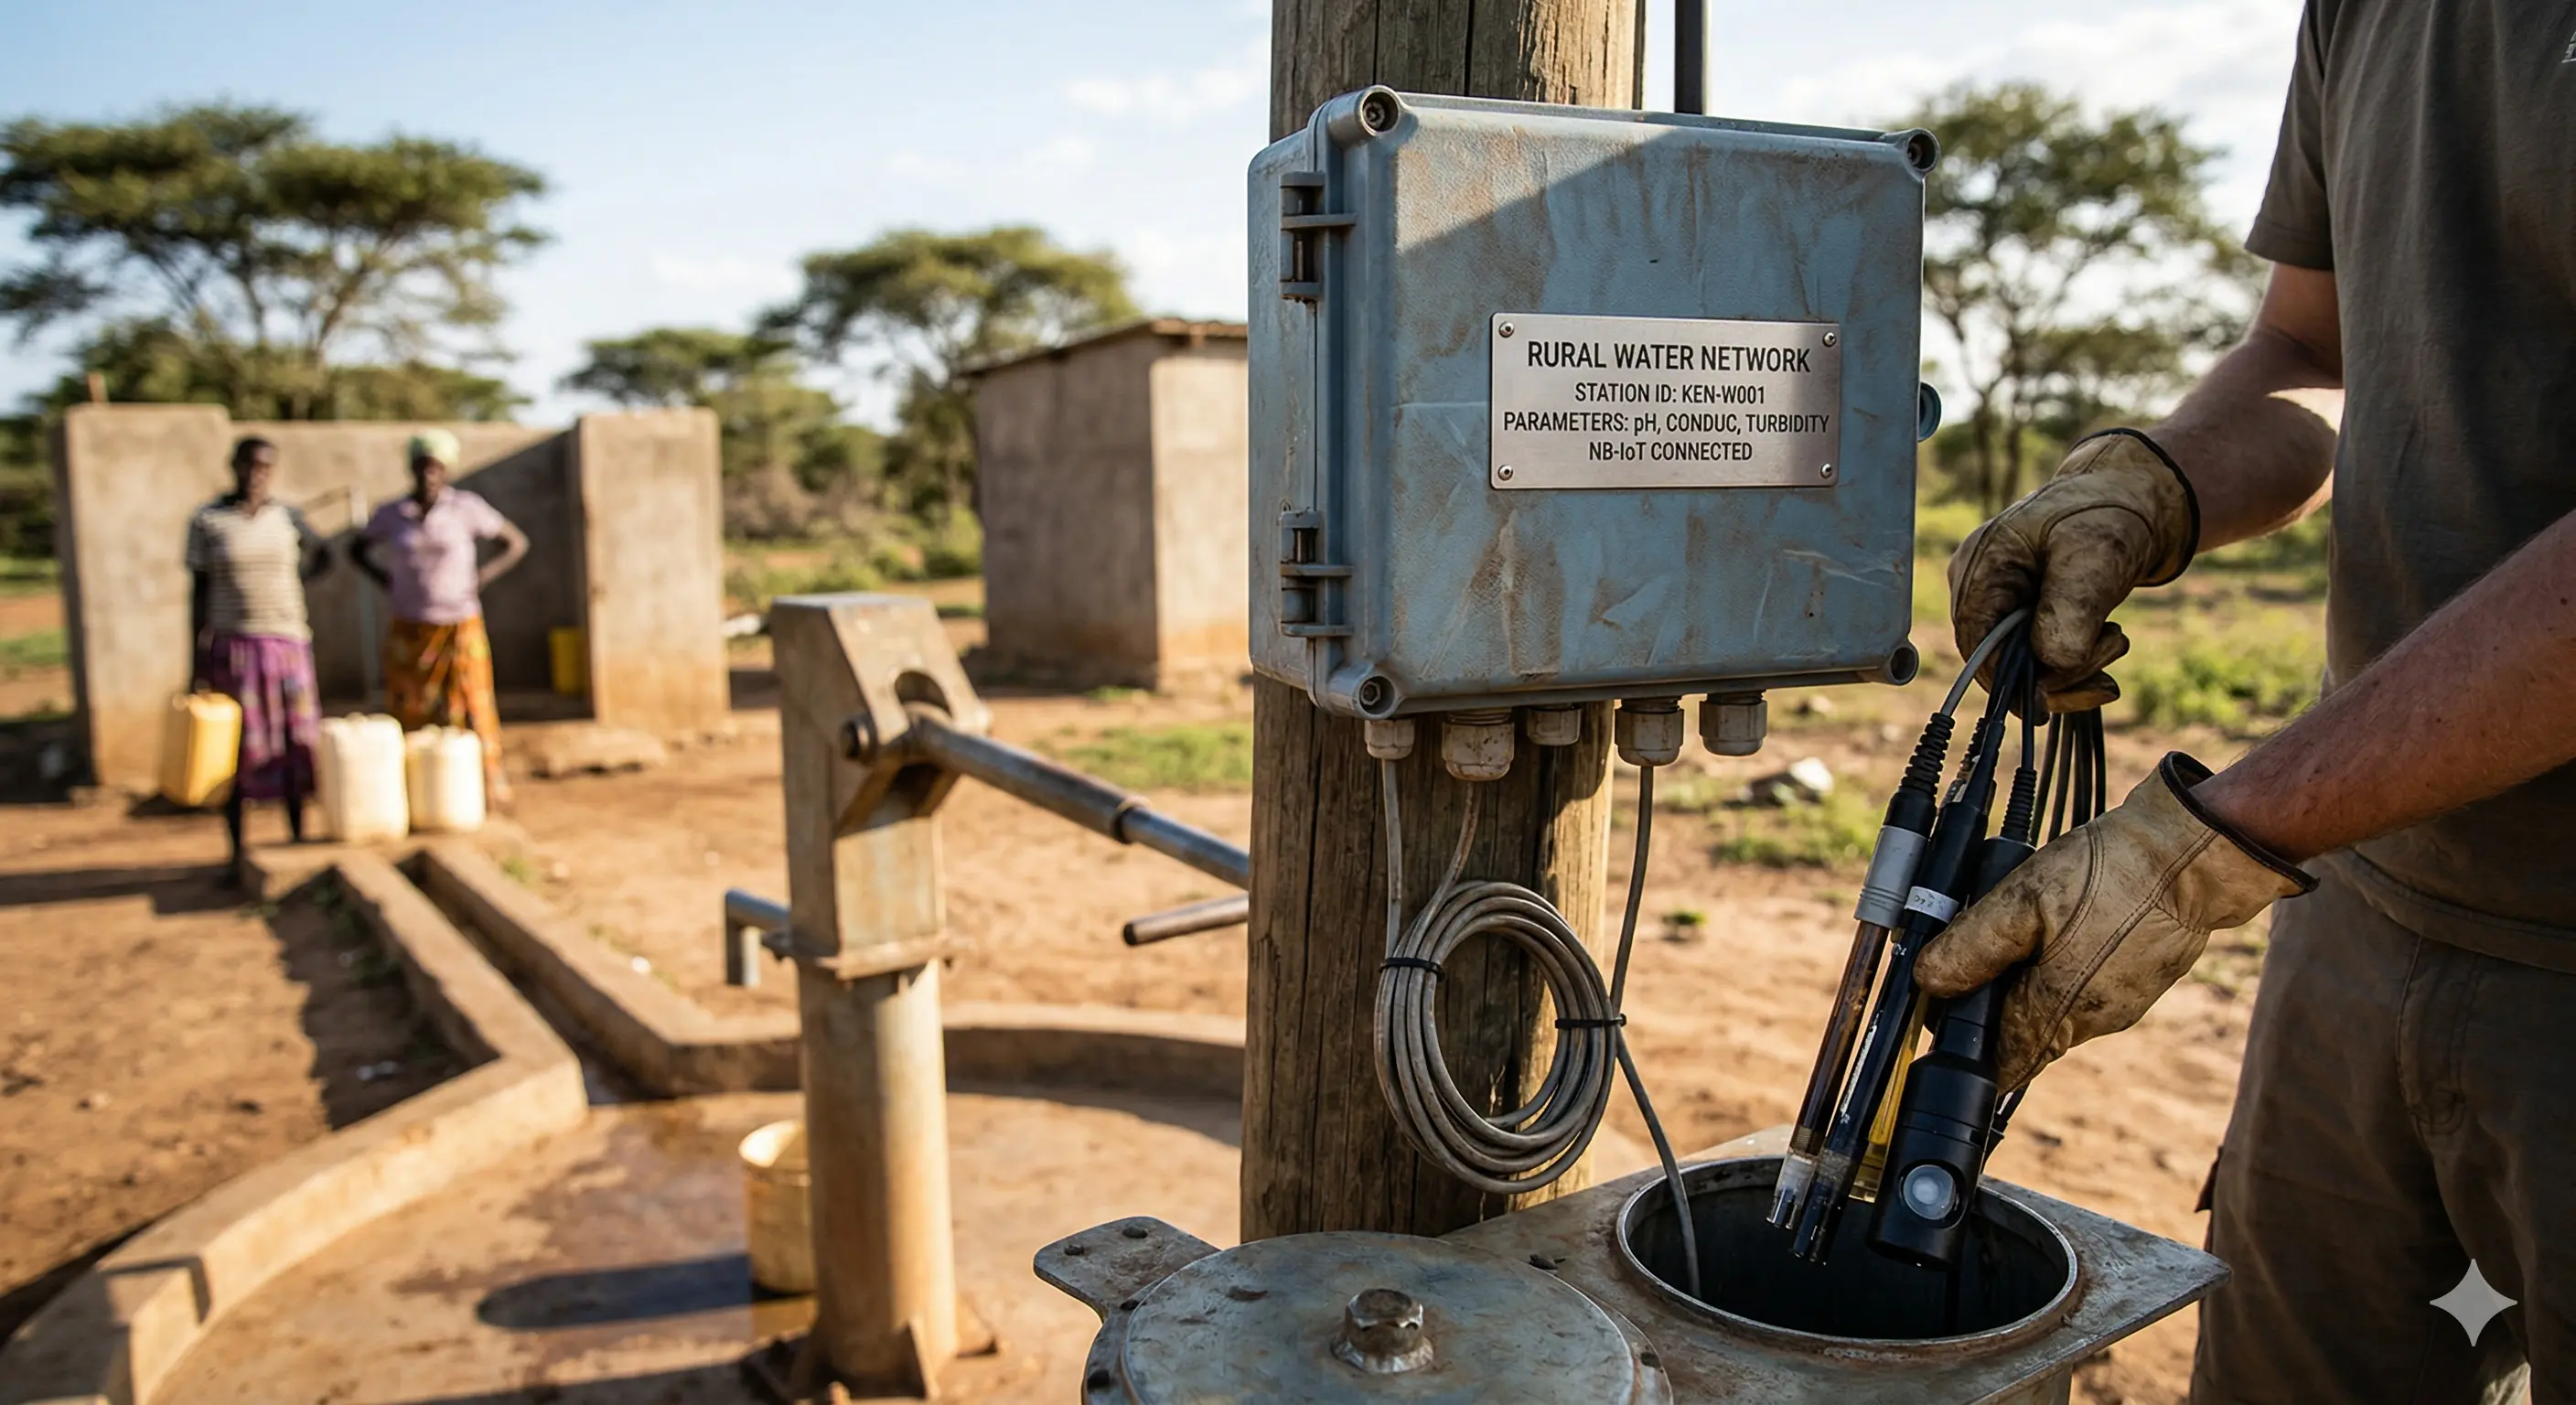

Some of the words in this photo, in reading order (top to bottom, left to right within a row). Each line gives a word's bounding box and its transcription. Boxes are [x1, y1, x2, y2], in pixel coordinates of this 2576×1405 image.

[1528, 341, 1607, 369] RURAL
[1615, 343, 1694, 370] WATER
[1701, 346, 1811, 373] NETWORK
[1575, 382, 1650, 403] STATION
[1655, 384, 1678, 403] ID:
[1682, 384, 1765, 405] KEN-W001
[1504, 412, 1629, 433] PARAMETERS:
[1634, 413, 1662, 437] pH,
[1666, 413, 1742, 436] CONDUC,
[1747, 414, 1830, 434] TURBIDITY
[1589, 442, 1648, 461] NB-IoT
[1650, 442, 1753, 461] CONNECTED
